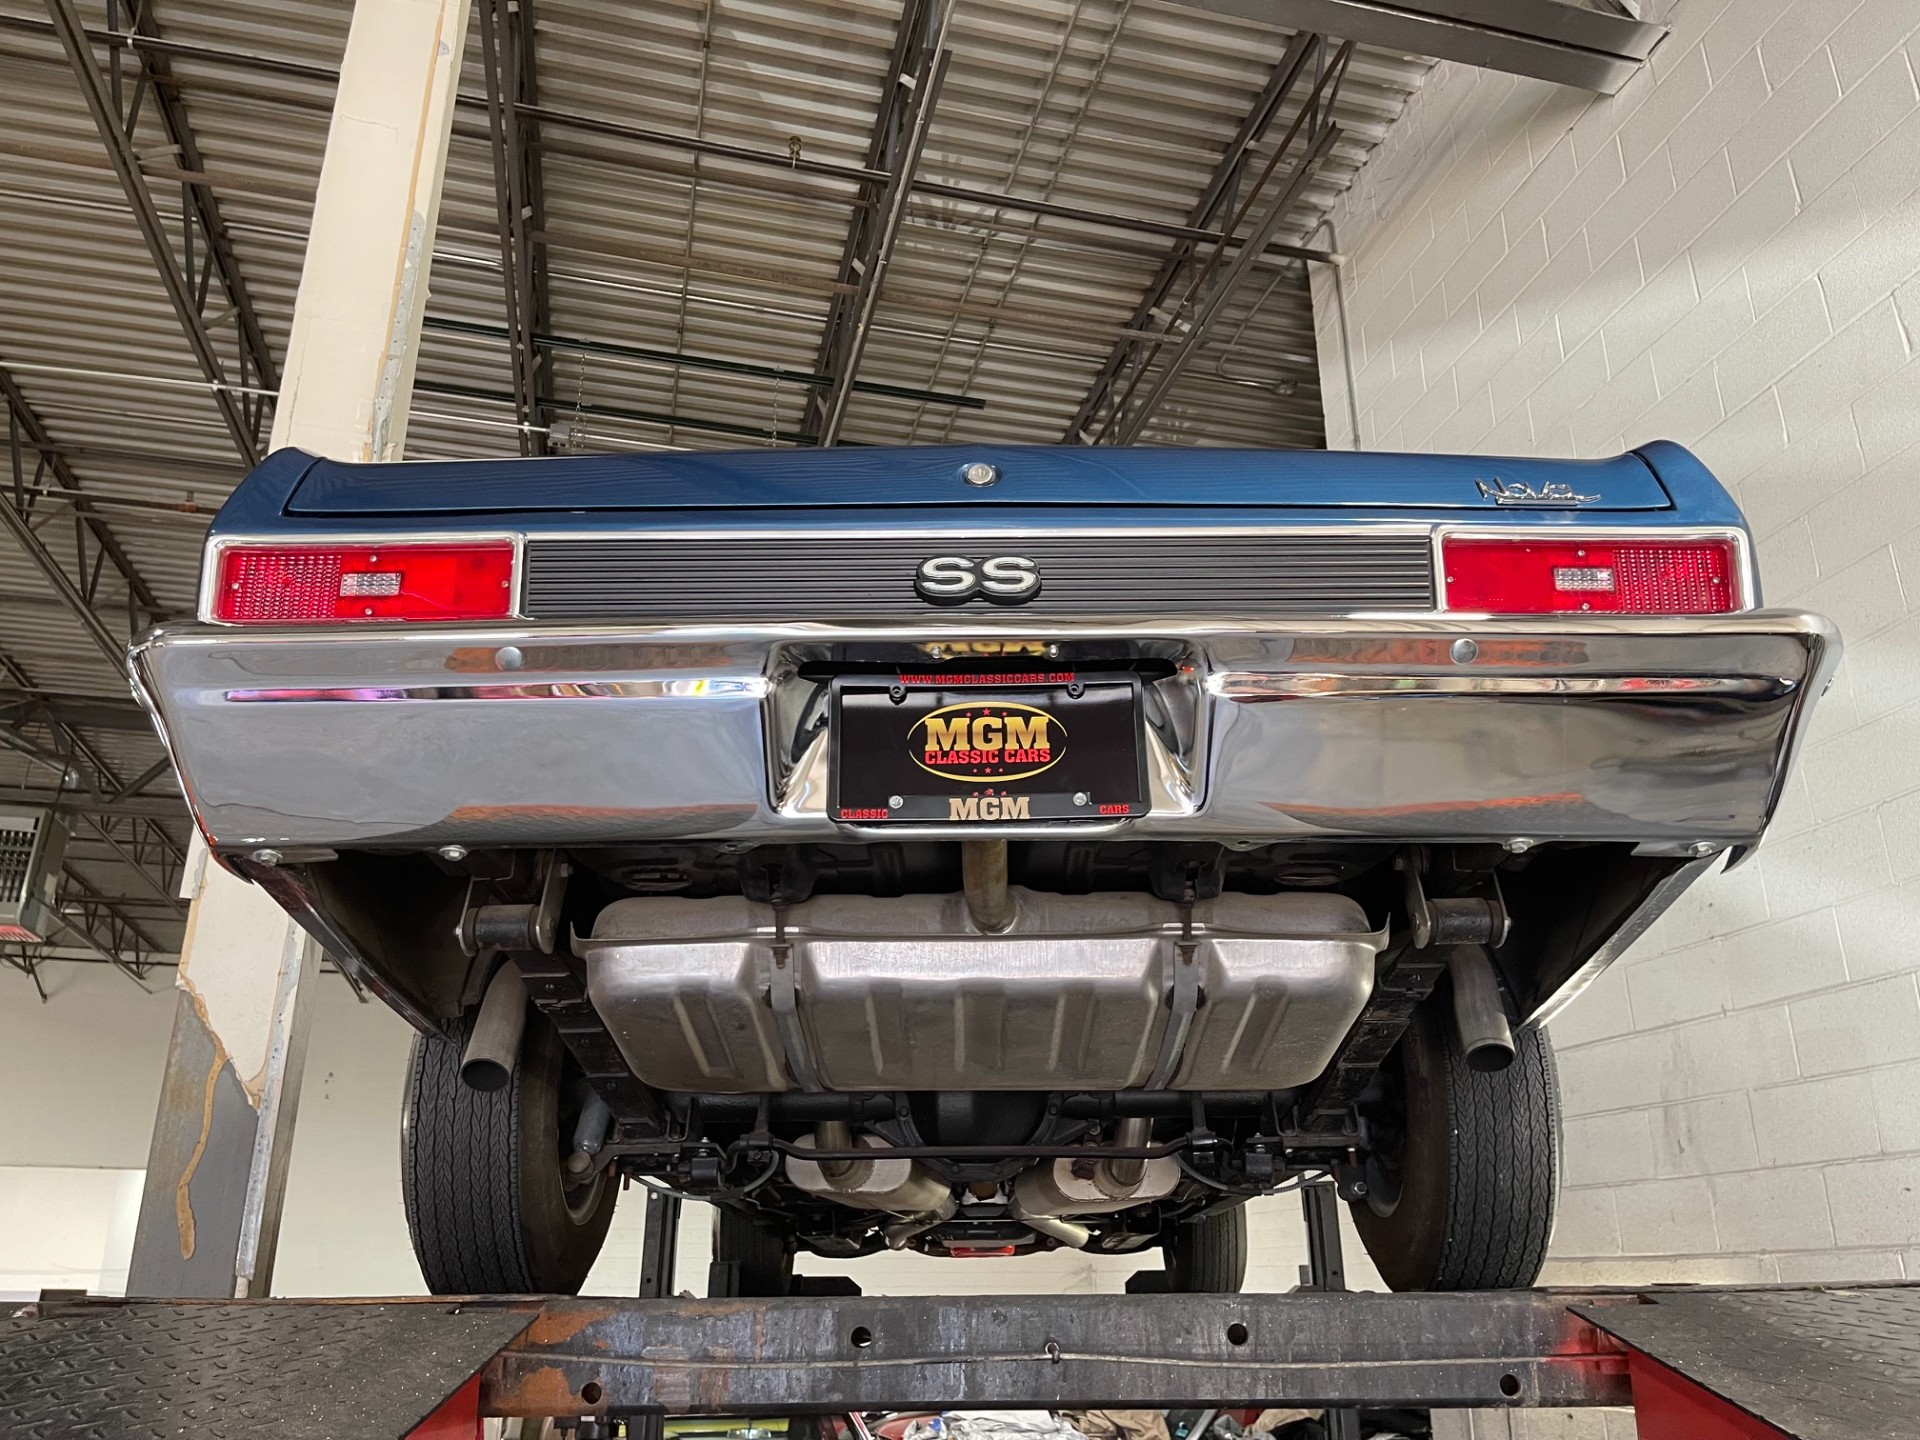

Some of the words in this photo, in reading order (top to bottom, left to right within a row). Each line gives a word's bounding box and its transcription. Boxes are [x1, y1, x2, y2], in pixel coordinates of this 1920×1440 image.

[1474, 476, 1601, 504] Nova
[920, 556, 1037, 594] SS
[899, 672, 1075, 685] WWW.MGMCLASSICCARS.COM
[924, 716, 1050, 752] MGM
[924, 750, 999, 765] CLASSIC
[1004, 749, 1051, 763] CARS
[840, 808, 889, 820] CLASSIC
[949, 796, 1031, 821] MGM
[1099, 803, 1130, 815] CARS
